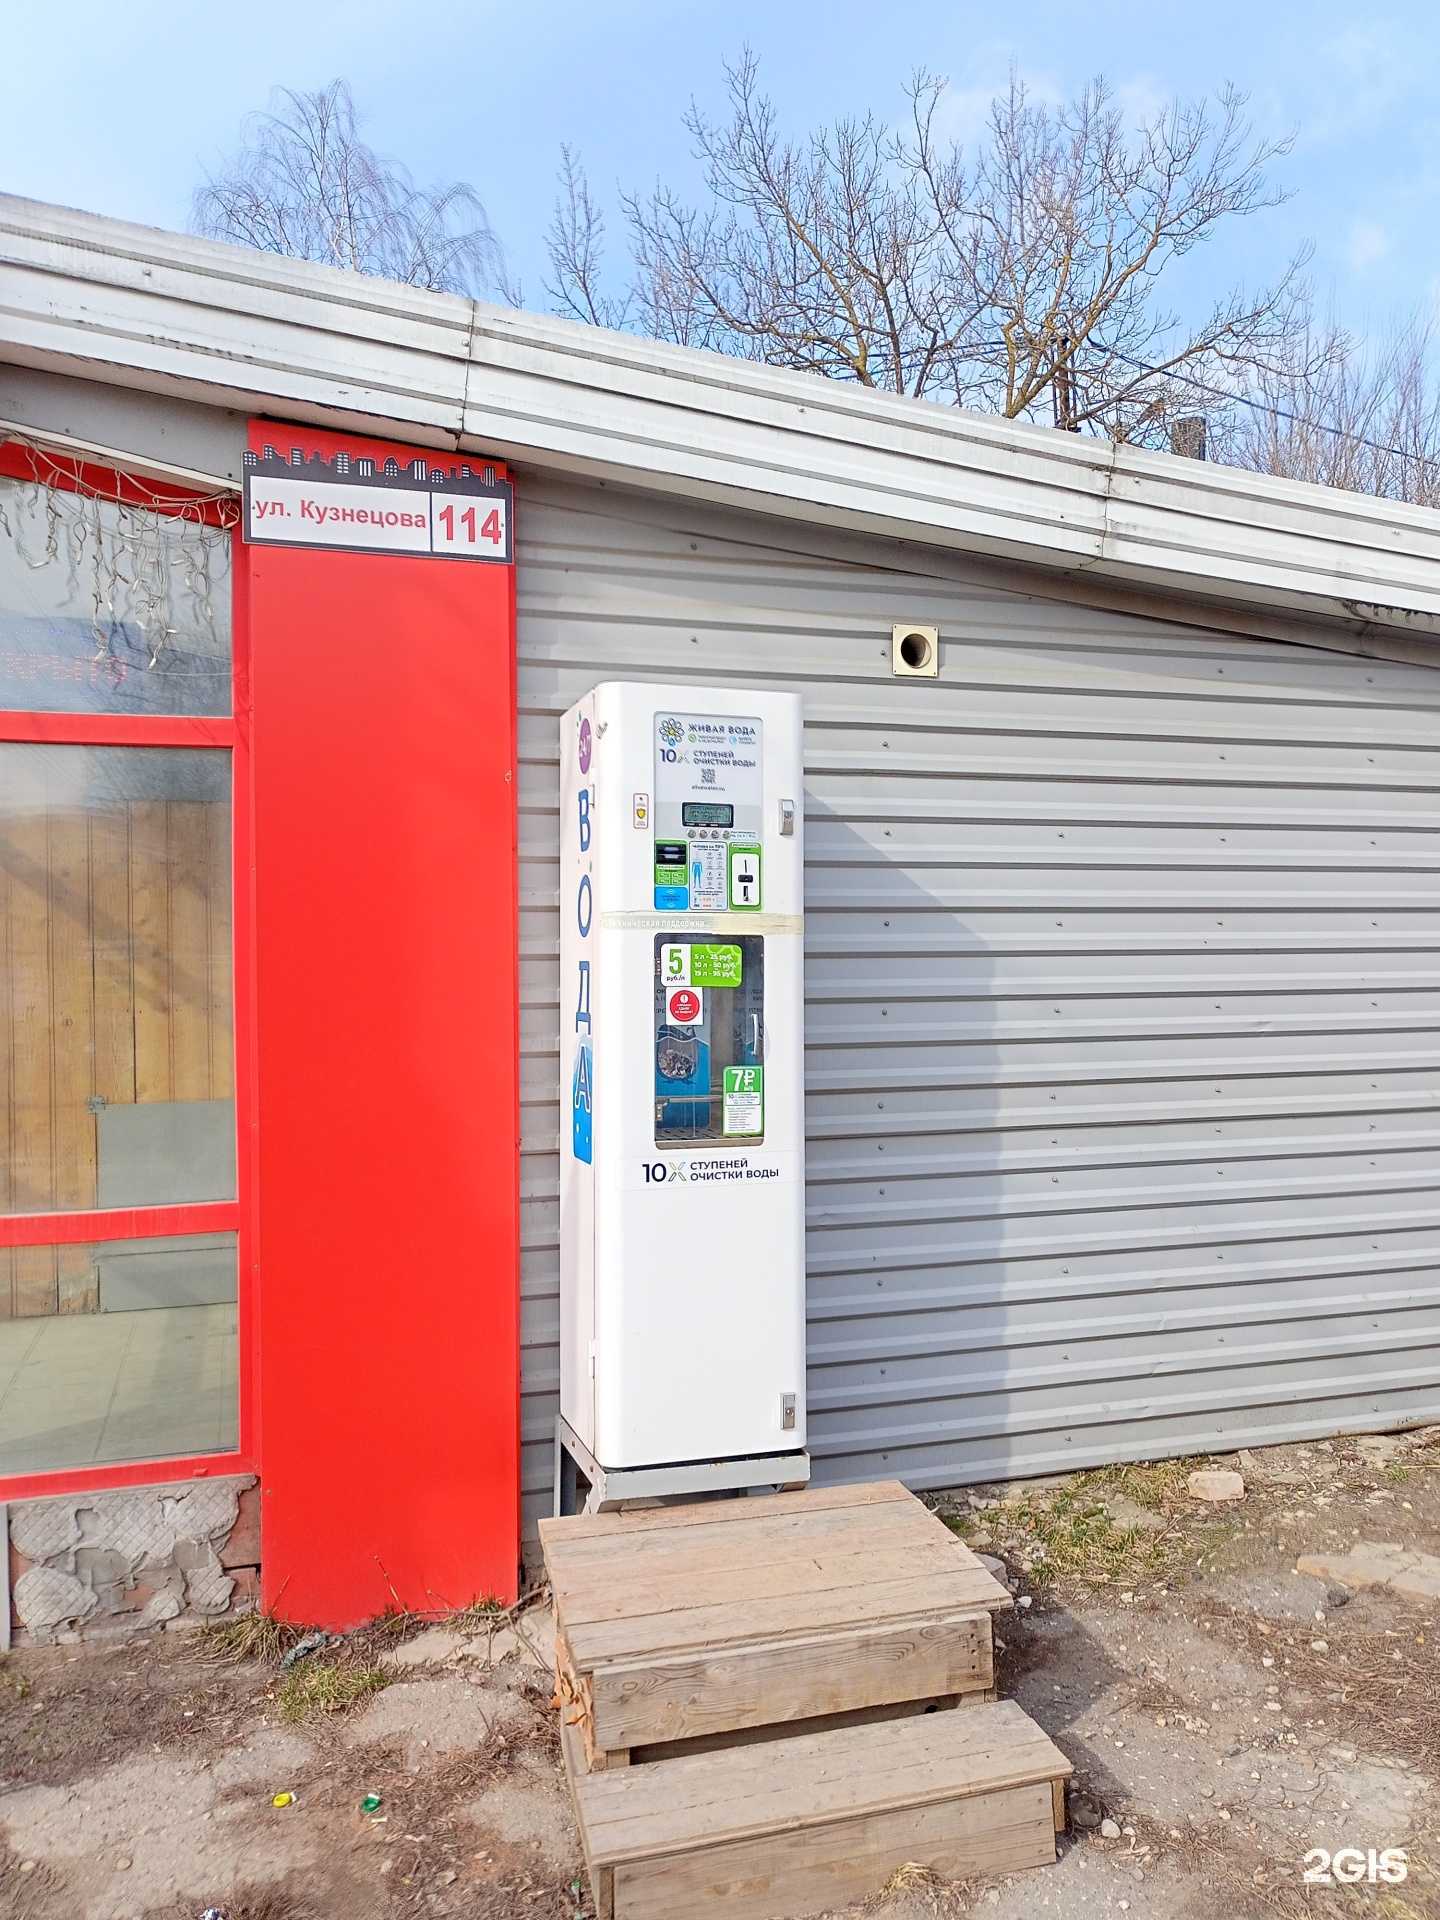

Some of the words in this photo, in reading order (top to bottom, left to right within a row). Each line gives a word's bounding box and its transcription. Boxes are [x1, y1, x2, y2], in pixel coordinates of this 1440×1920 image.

[256, 500, 291, 519] ул.
[300, 499, 426, 528] Кузнецова
[439, 504, 502, 545] 114
[688, 723, 725, 733] ЖИВАЯ
[728, 725, 756, 736] ВОДА
[693, 750, 735, 758] СТУПЕНЕЙ
[693, 757, 731, 766] ОЧИСТКИ
[669, 948, 683, 975] 5
[690, 1157, 748, 1170] СТУПЕНЕЙ
[690, 1170, 743, 1181] ОЧИСТКИ
[746, 1168, 779, 1179] ВОДЫ
